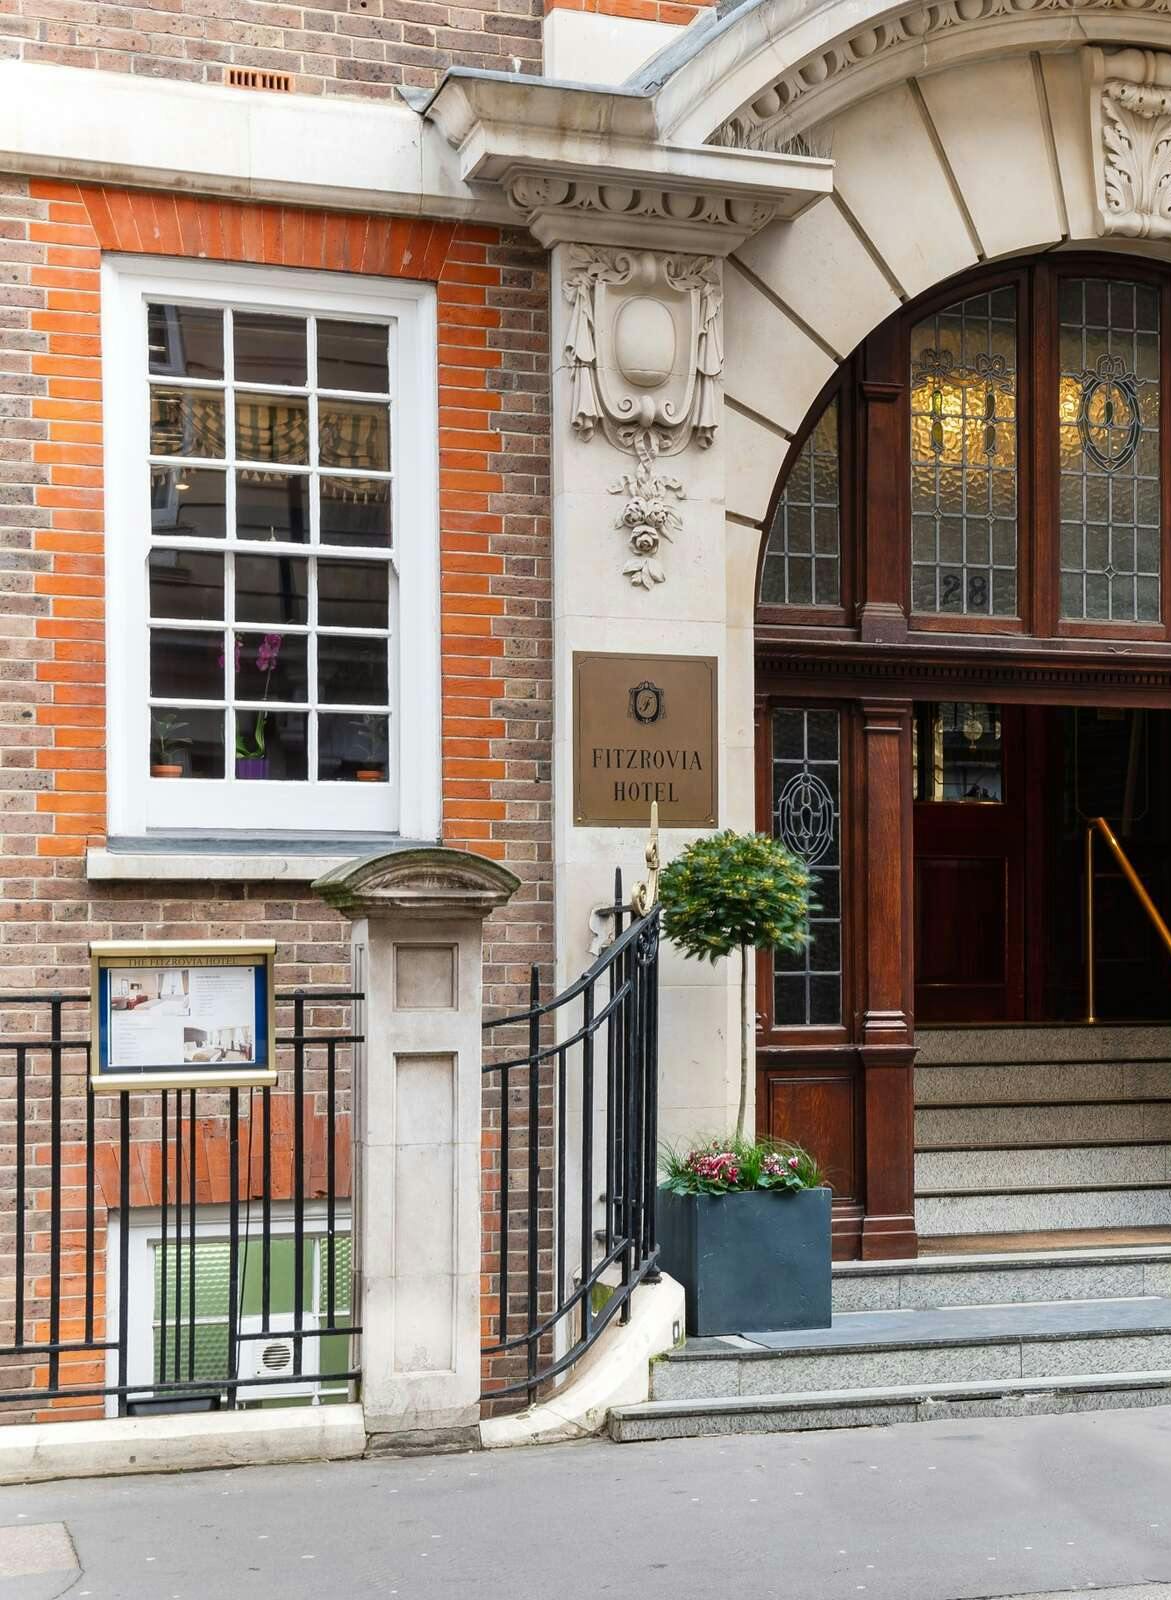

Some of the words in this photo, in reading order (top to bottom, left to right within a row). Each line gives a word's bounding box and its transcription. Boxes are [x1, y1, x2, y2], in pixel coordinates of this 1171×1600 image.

[943, 575, 987, 606] 28
[592, 748, 703, 771] FITZROVIA
[613, 781, 679, 802] HOTEL
[150, 958, 203, 967] FITZROVIA
[206, 957, 237, 965] HOTEL
